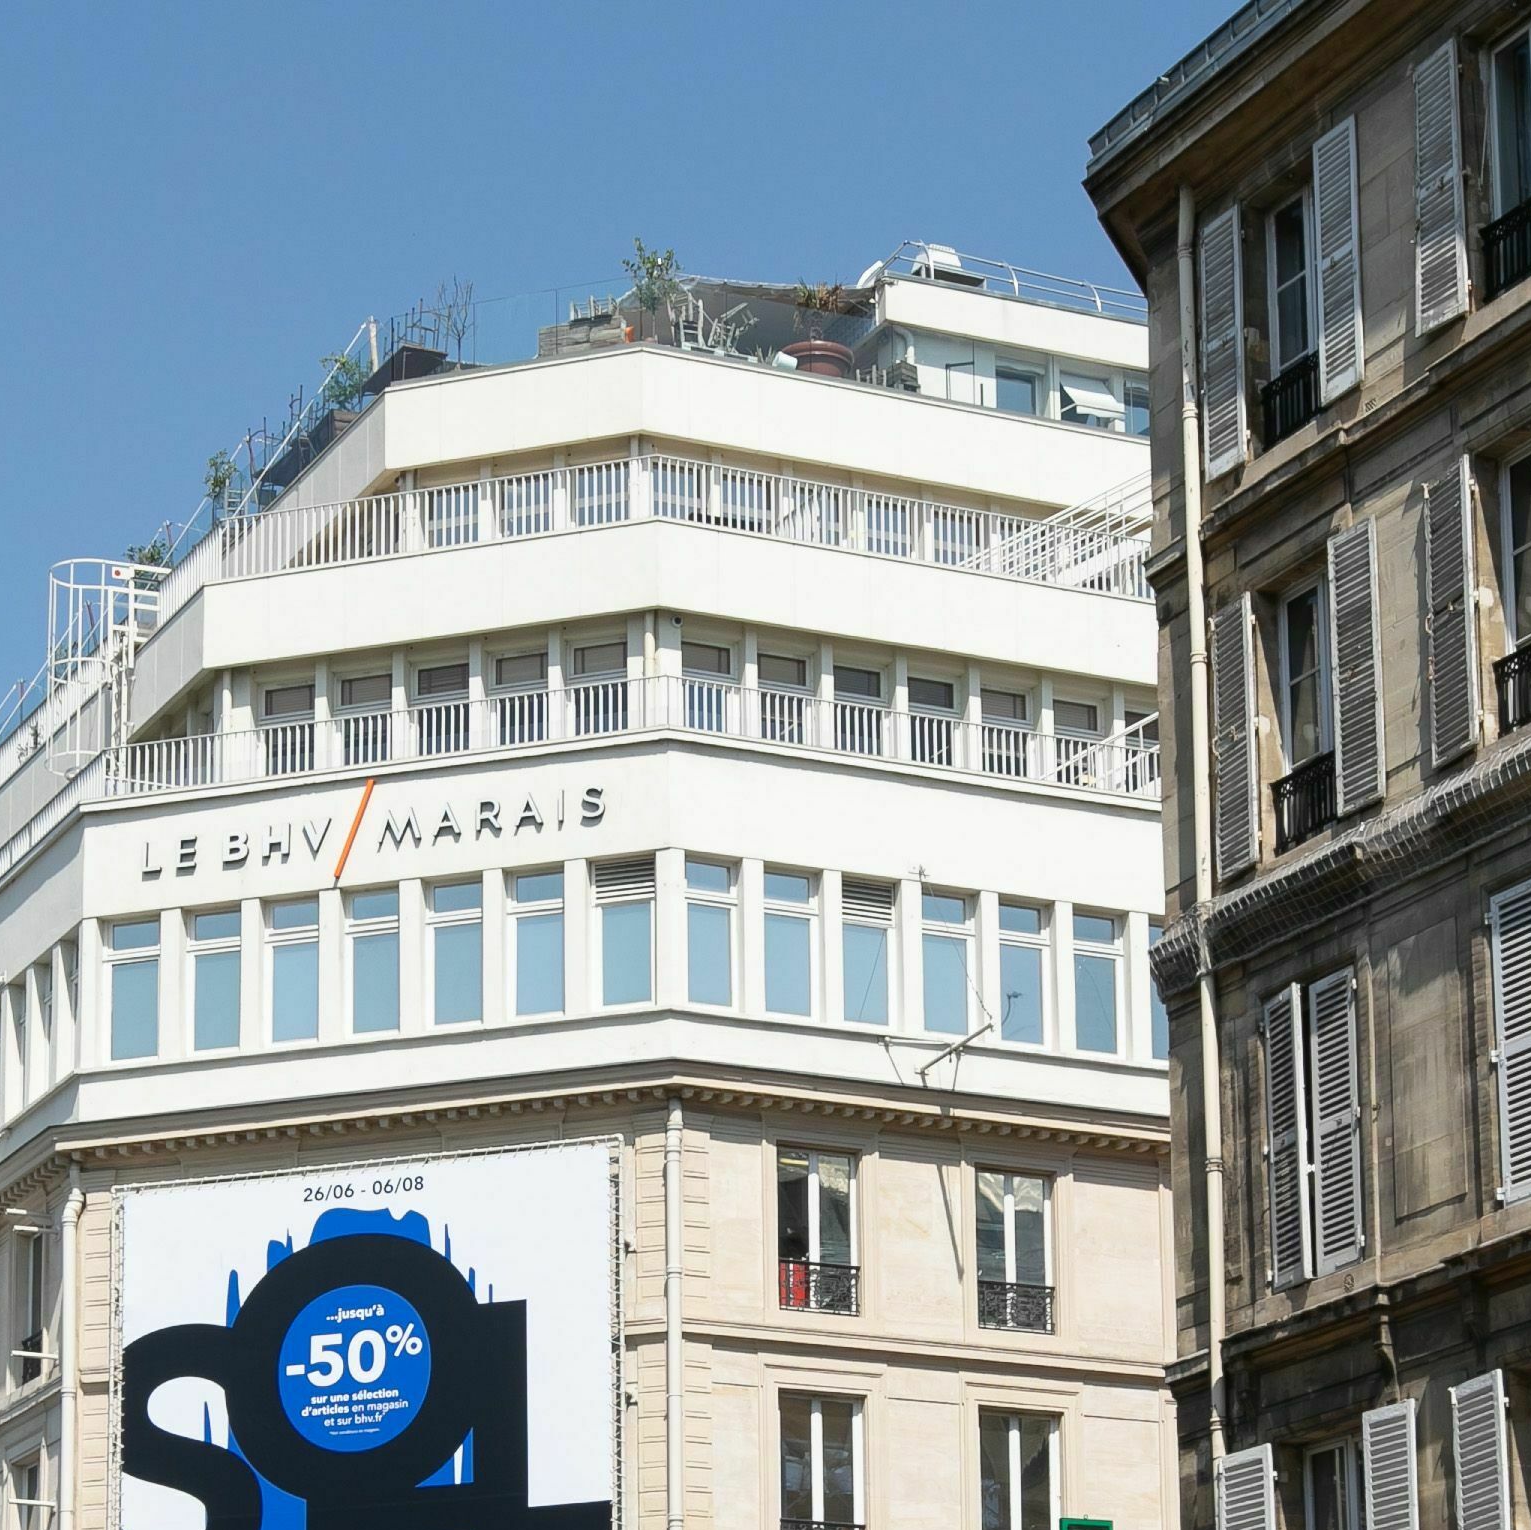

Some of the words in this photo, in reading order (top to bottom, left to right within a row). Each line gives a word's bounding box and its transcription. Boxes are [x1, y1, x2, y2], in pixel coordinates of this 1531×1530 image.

[141, 835, 198, 874] LE
[222, 817, 332, 865] BHV
[376, 786, 606, 854] MARAIS
[302, 1181, 352, 1204] 26/06
[370, 1176, 425, 1198] 06/08
[285, 1322, 423, 1387] -50%
[311, 1394, 328, 1404] sur
[329, 1393, 350, 1403] une
[351, 1388, 399, 1401] sélection
[301, 1403, 350, 1417] d'articles
[351, 1404, 364, 1413] en
[367, 1399, 409, 1413] magasin
[324, 1416, 335, 1427] et
[336, 1416, 352, 1426] sur
